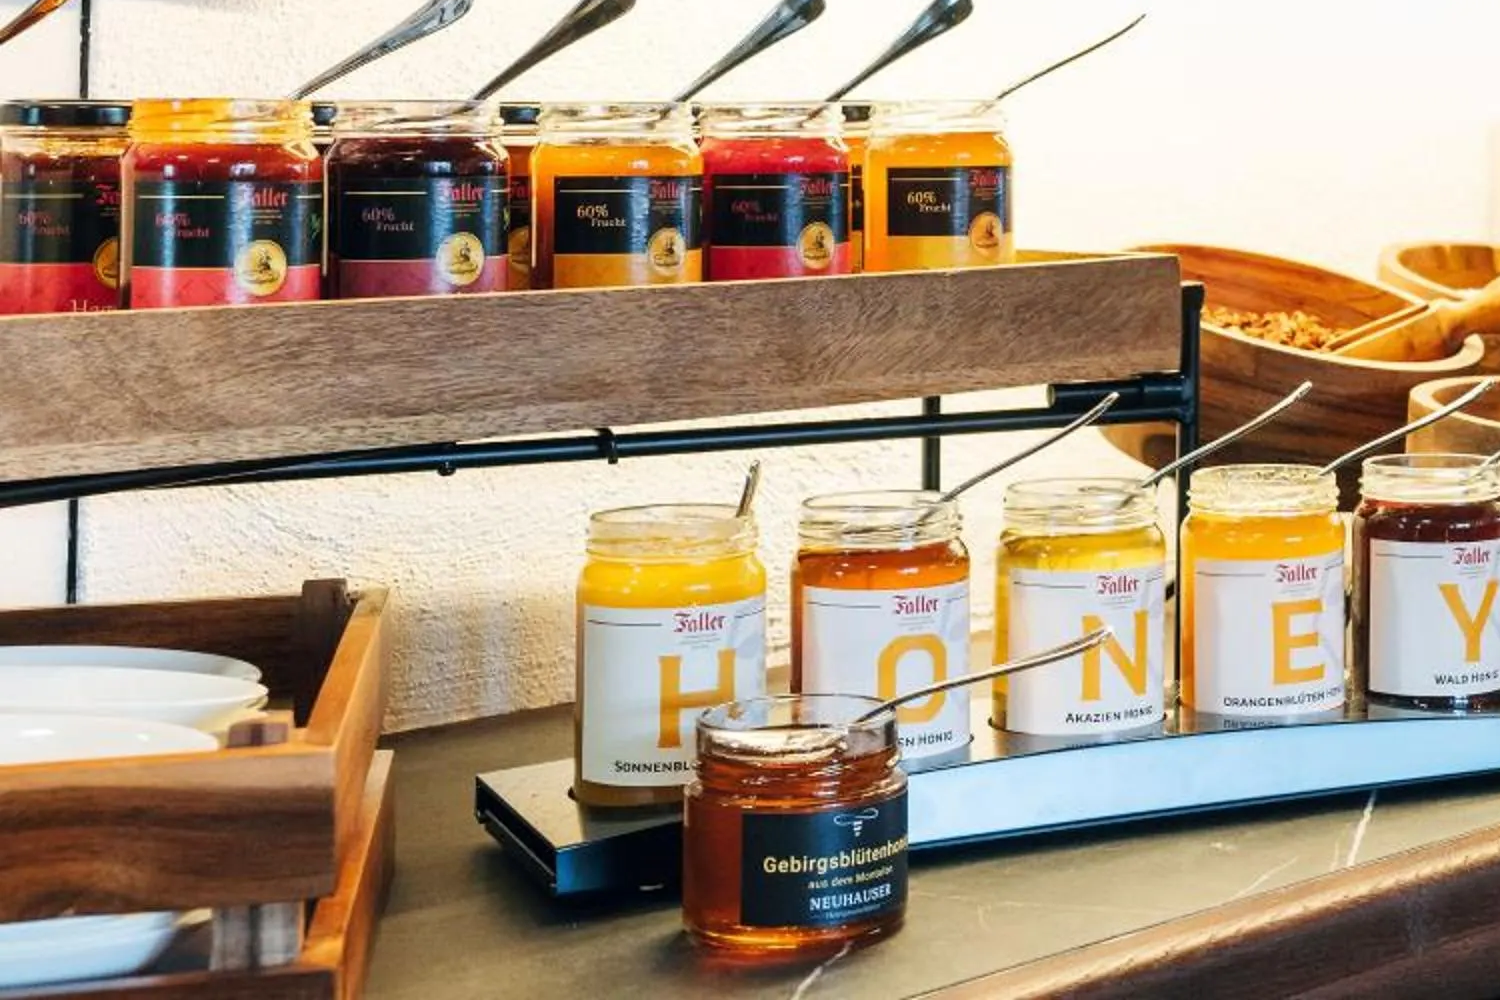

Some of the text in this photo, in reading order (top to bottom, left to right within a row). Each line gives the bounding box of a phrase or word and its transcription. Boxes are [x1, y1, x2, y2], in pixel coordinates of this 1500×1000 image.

[907, 190, 937, 204] 60%
[361, 206, 396, 222] 60%
[576, 202, 609, 219] 60%
[591, 216, 627, 228] Frucht
[1453, 547, 1491, 565] Faller
[1275, 563, 1318, 583] Faller
[1097, 575, 1140, 595] Faller
[892, 595, 939, 615] Faller
[673, 612, 727, 633] Faller
[1439, 578, 1500, 663] Y
[1272, 599, 1325, 685] E
[1081, 610, 1149, 701] N
[877, 633, 948, 724] O
[656, 649, 736, 748] H
[1065, 711, 1121, 724] AKAZIEN
[614, 760, 702, 773] SONNENBL
[809, 883, 892, 911] NEUHAUSER
